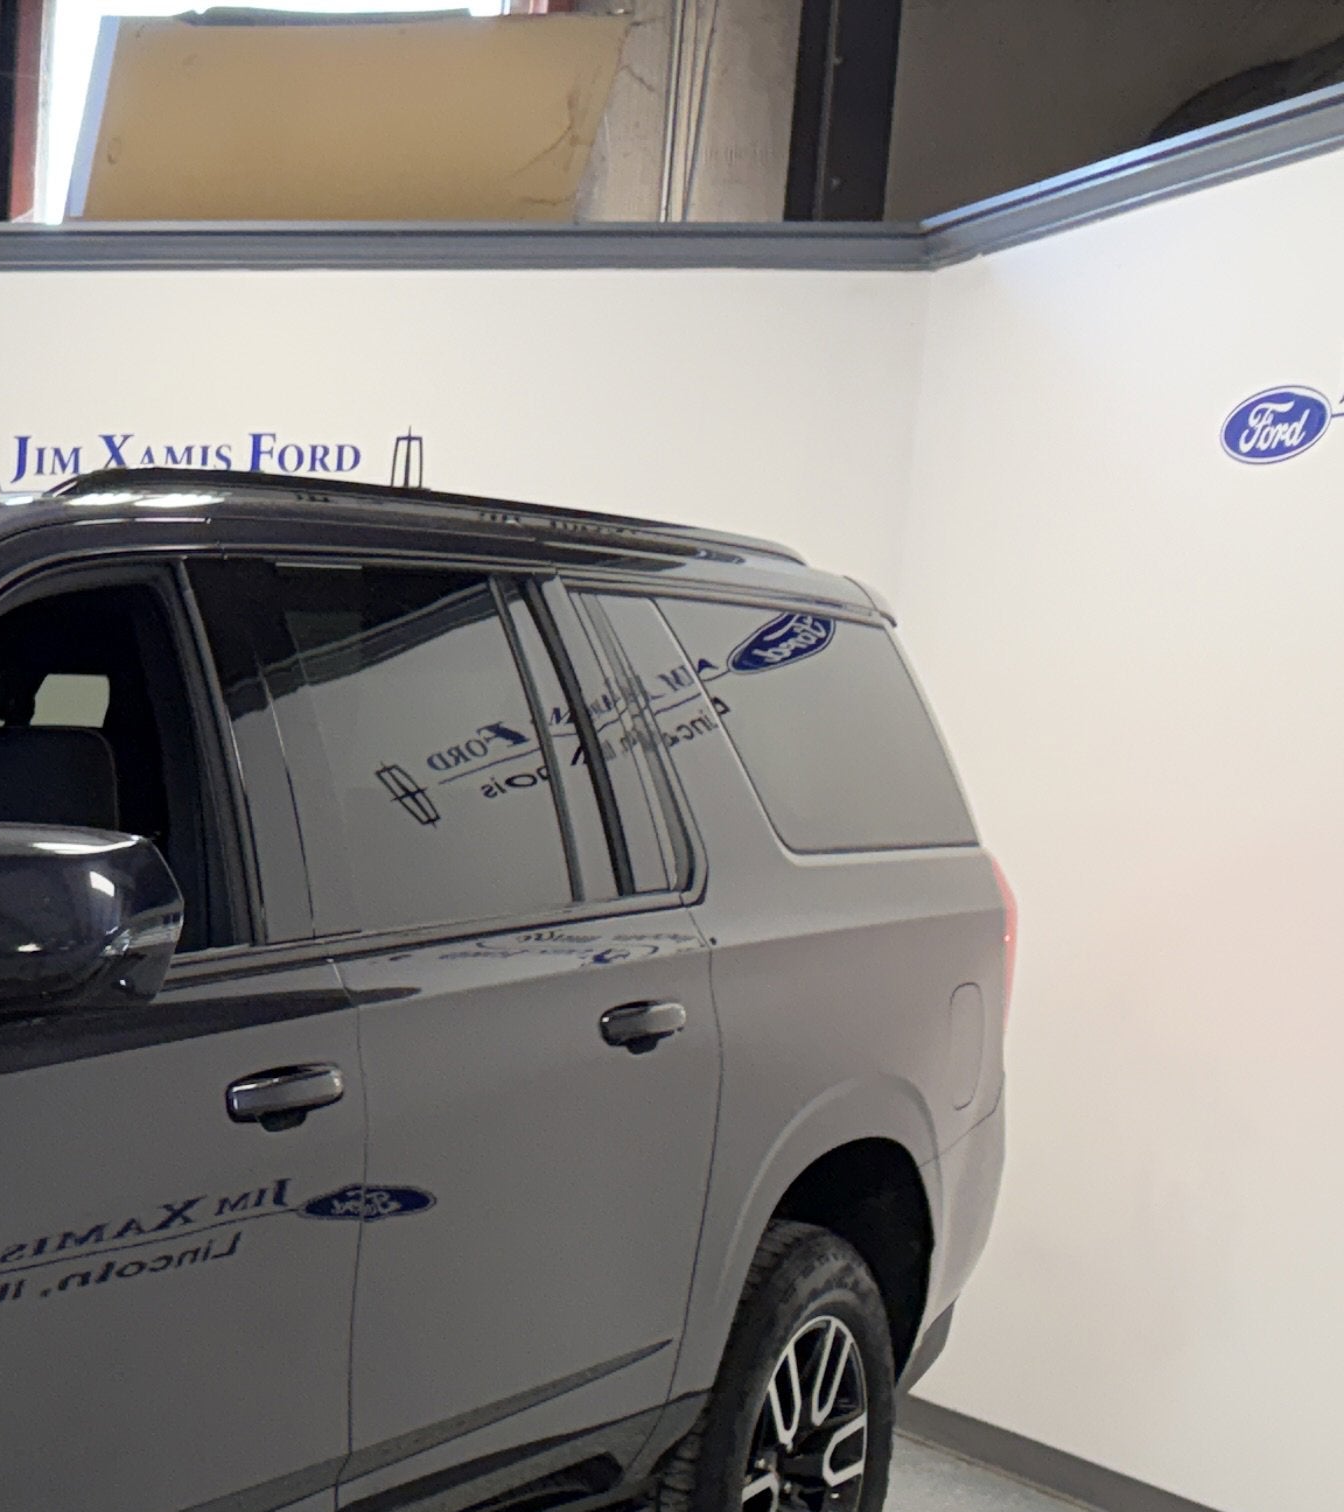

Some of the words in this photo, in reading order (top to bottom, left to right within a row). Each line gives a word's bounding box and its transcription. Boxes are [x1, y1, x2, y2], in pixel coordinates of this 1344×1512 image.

[1239, 400, 1310, 453] Ford
[10, 435, 82, 484] JIM
[98, 434, 232, 472] XAMIS
[249, 432, 361, 473] FORD
